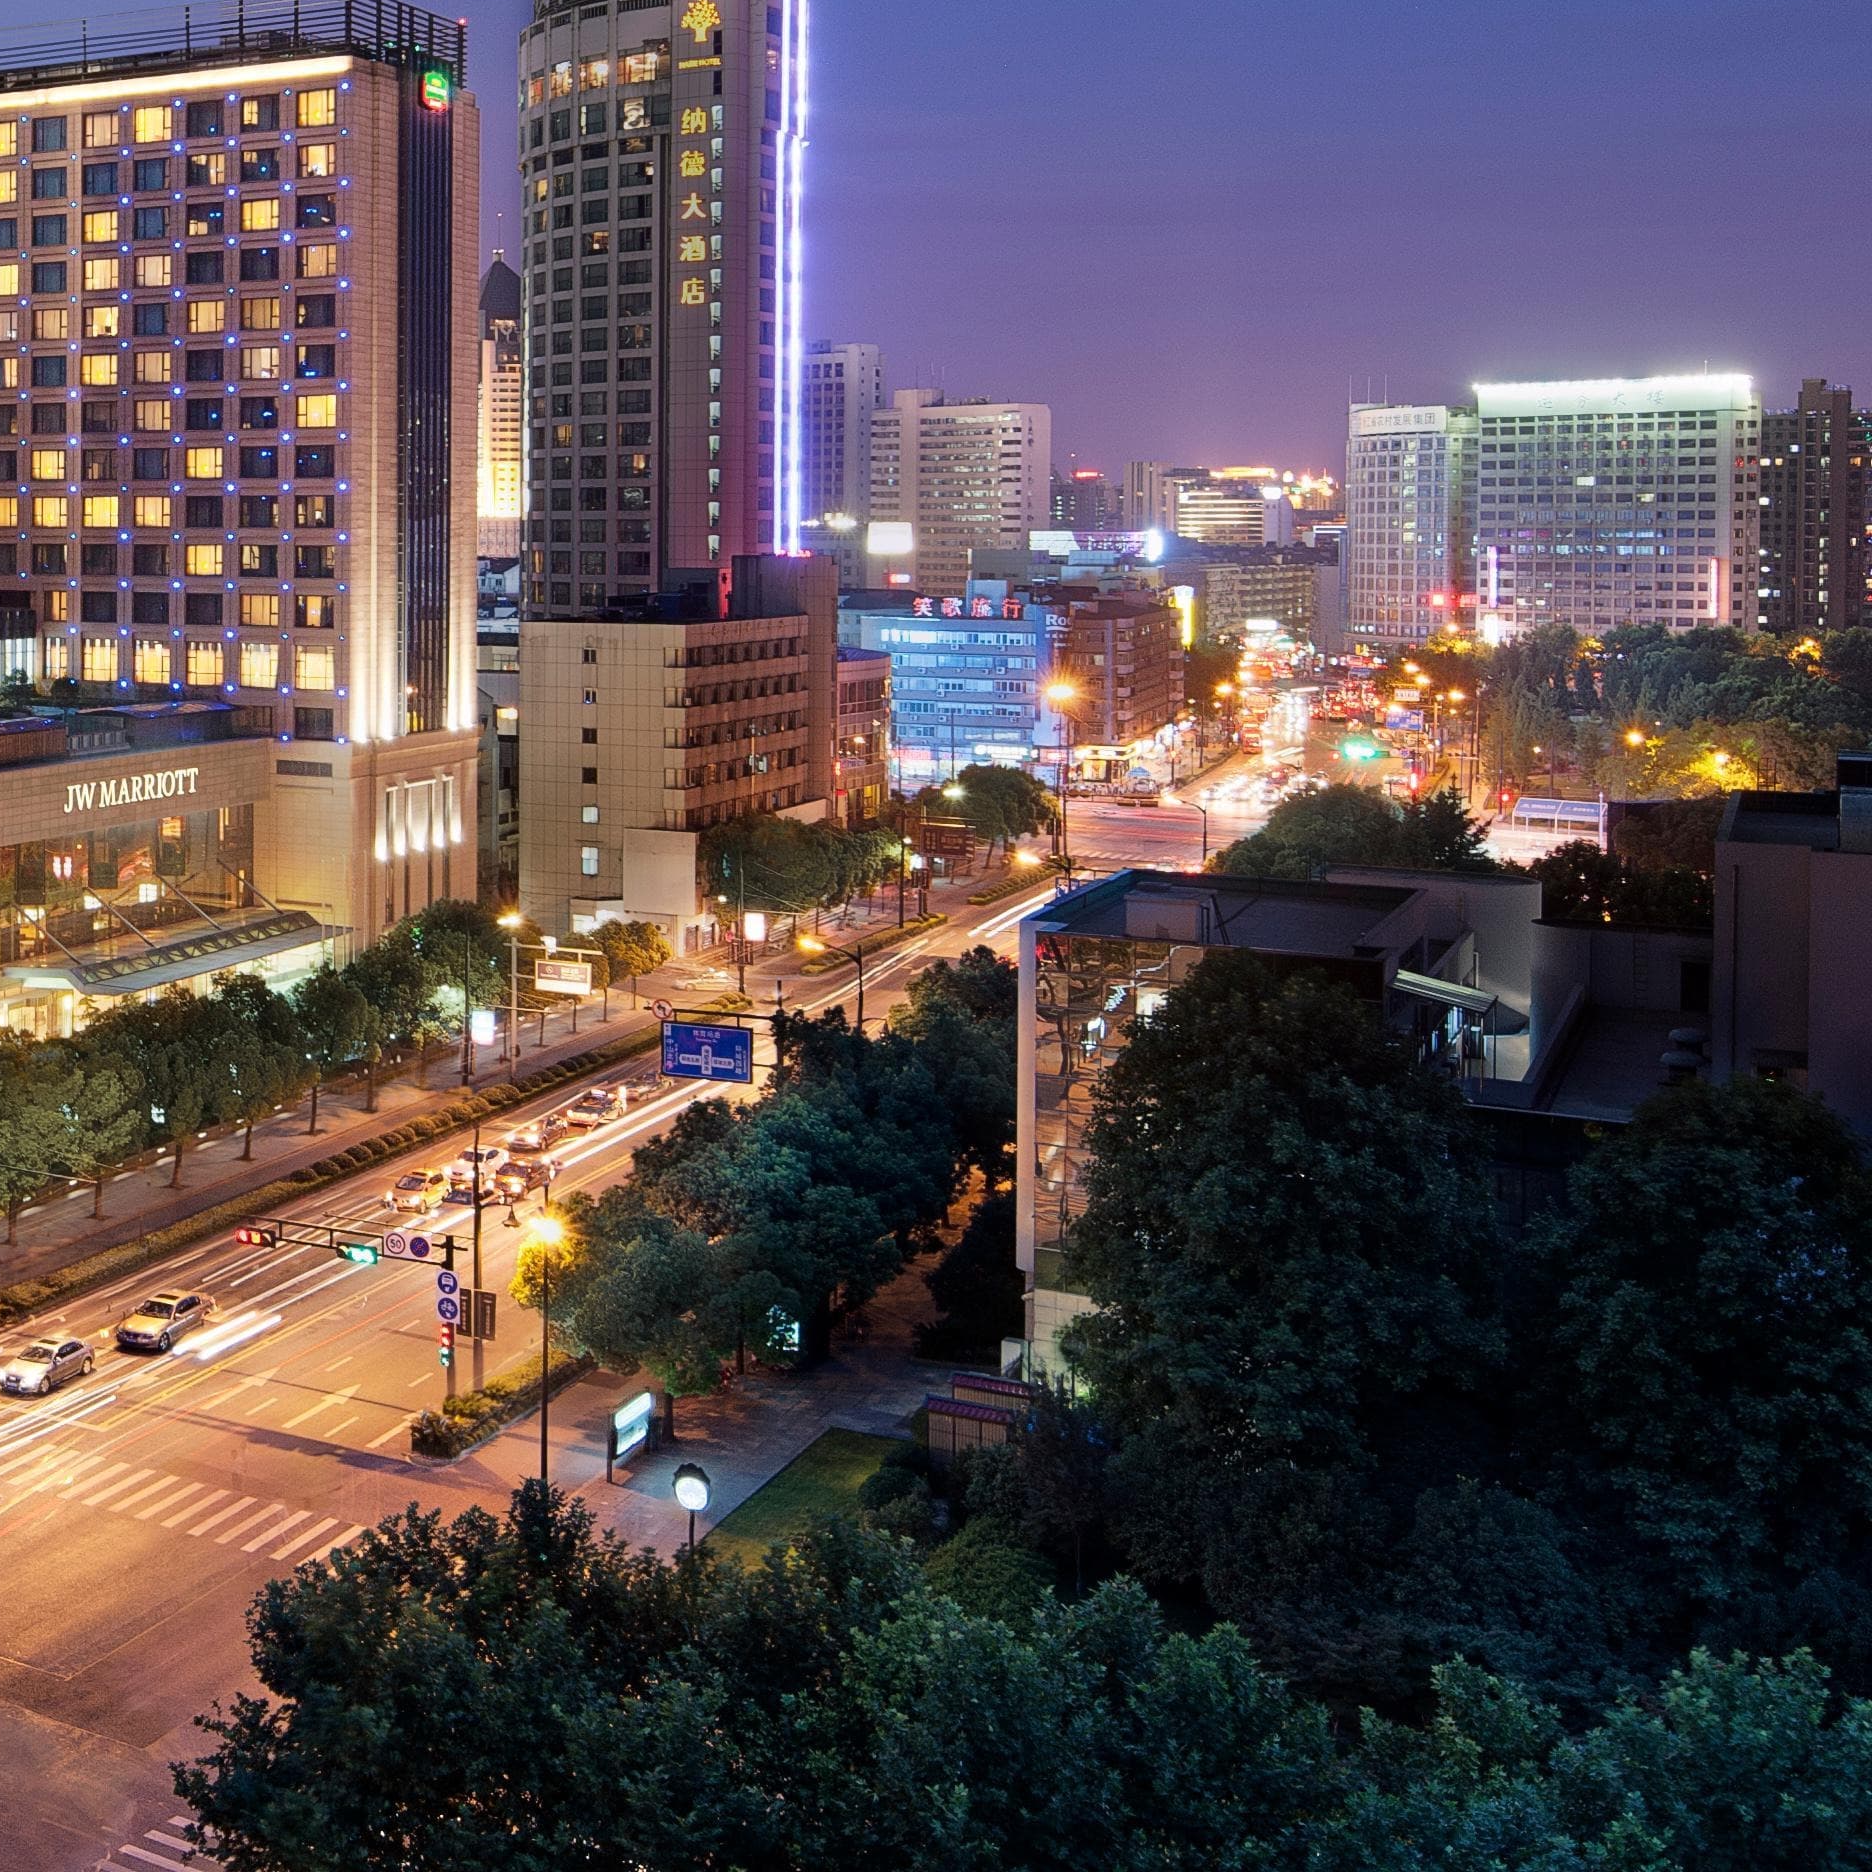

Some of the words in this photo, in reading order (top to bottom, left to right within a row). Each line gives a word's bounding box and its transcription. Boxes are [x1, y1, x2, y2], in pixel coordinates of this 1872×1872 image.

[680, 107, 707, 305] 纳德大酒店
[64, 782, 96, 813] JW
[98, 767, 199, 808] MARRIOTT
[389, 1238, 402, 1249] 50
